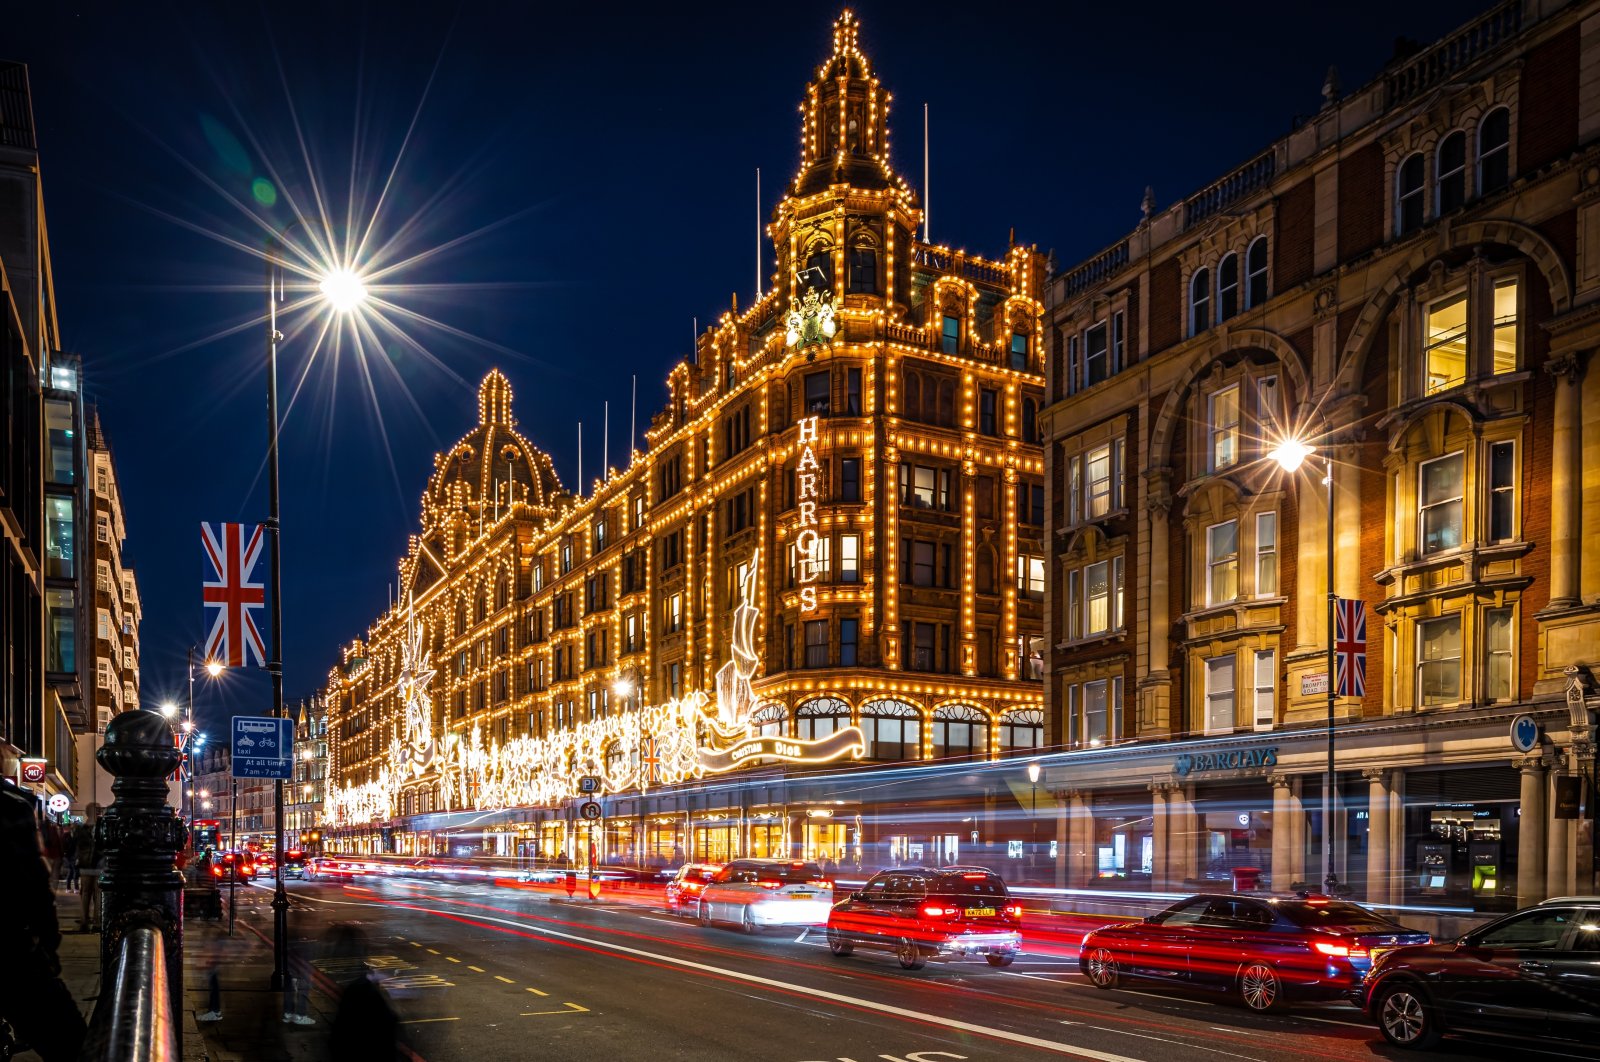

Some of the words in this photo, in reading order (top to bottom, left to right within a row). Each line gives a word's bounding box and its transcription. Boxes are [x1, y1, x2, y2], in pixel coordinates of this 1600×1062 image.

[797, 416, 819, 612] HARRODS
[267, 759, 286, 767] times
[1194, 748, 1277, 771] BARCLAYS
[584, 779, 591, 789] P
